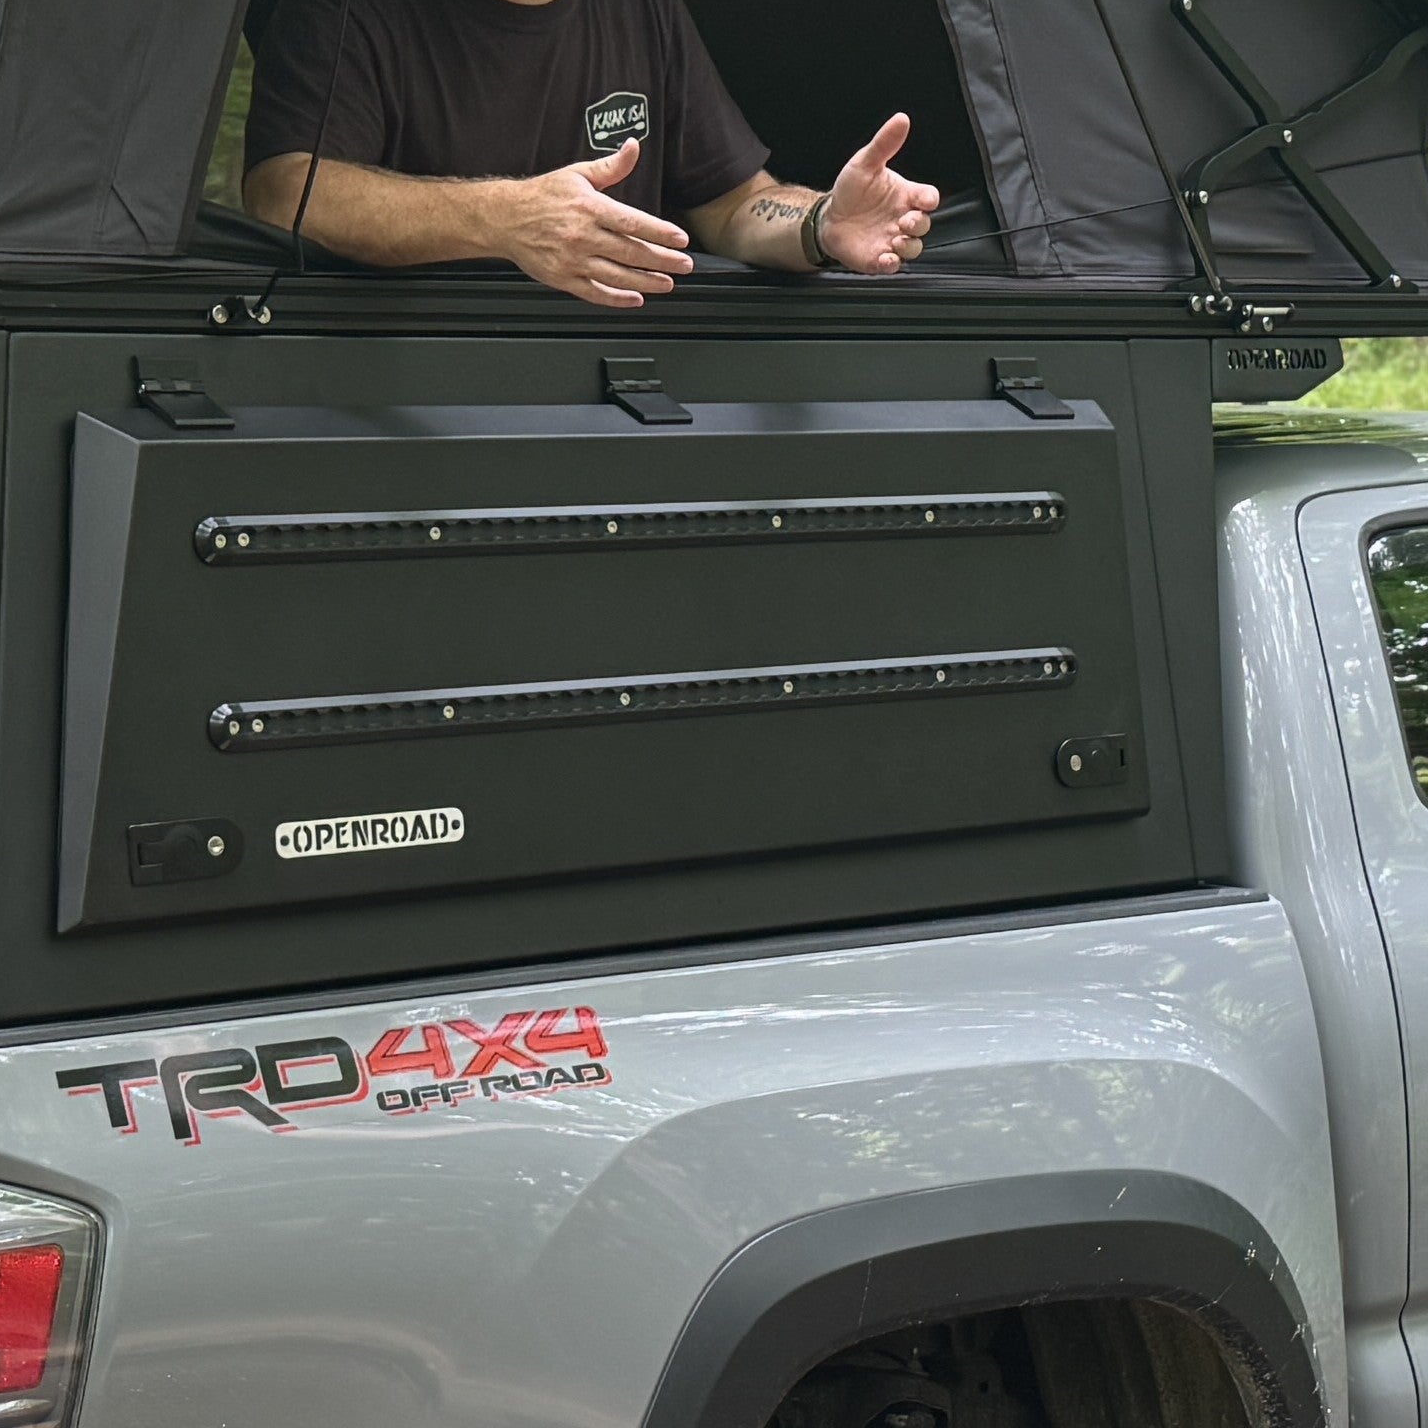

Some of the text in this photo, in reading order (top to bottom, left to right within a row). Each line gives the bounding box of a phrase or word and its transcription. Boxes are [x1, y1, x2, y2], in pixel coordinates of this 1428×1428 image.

[1227, 347, 1328, 370] OPENROAD
[292, 812, 450, 854] OPENROAD
[56, 1005, 609, 1146] TRD 4X4
[375, 1061, 613, 1116] OFF ROAD
